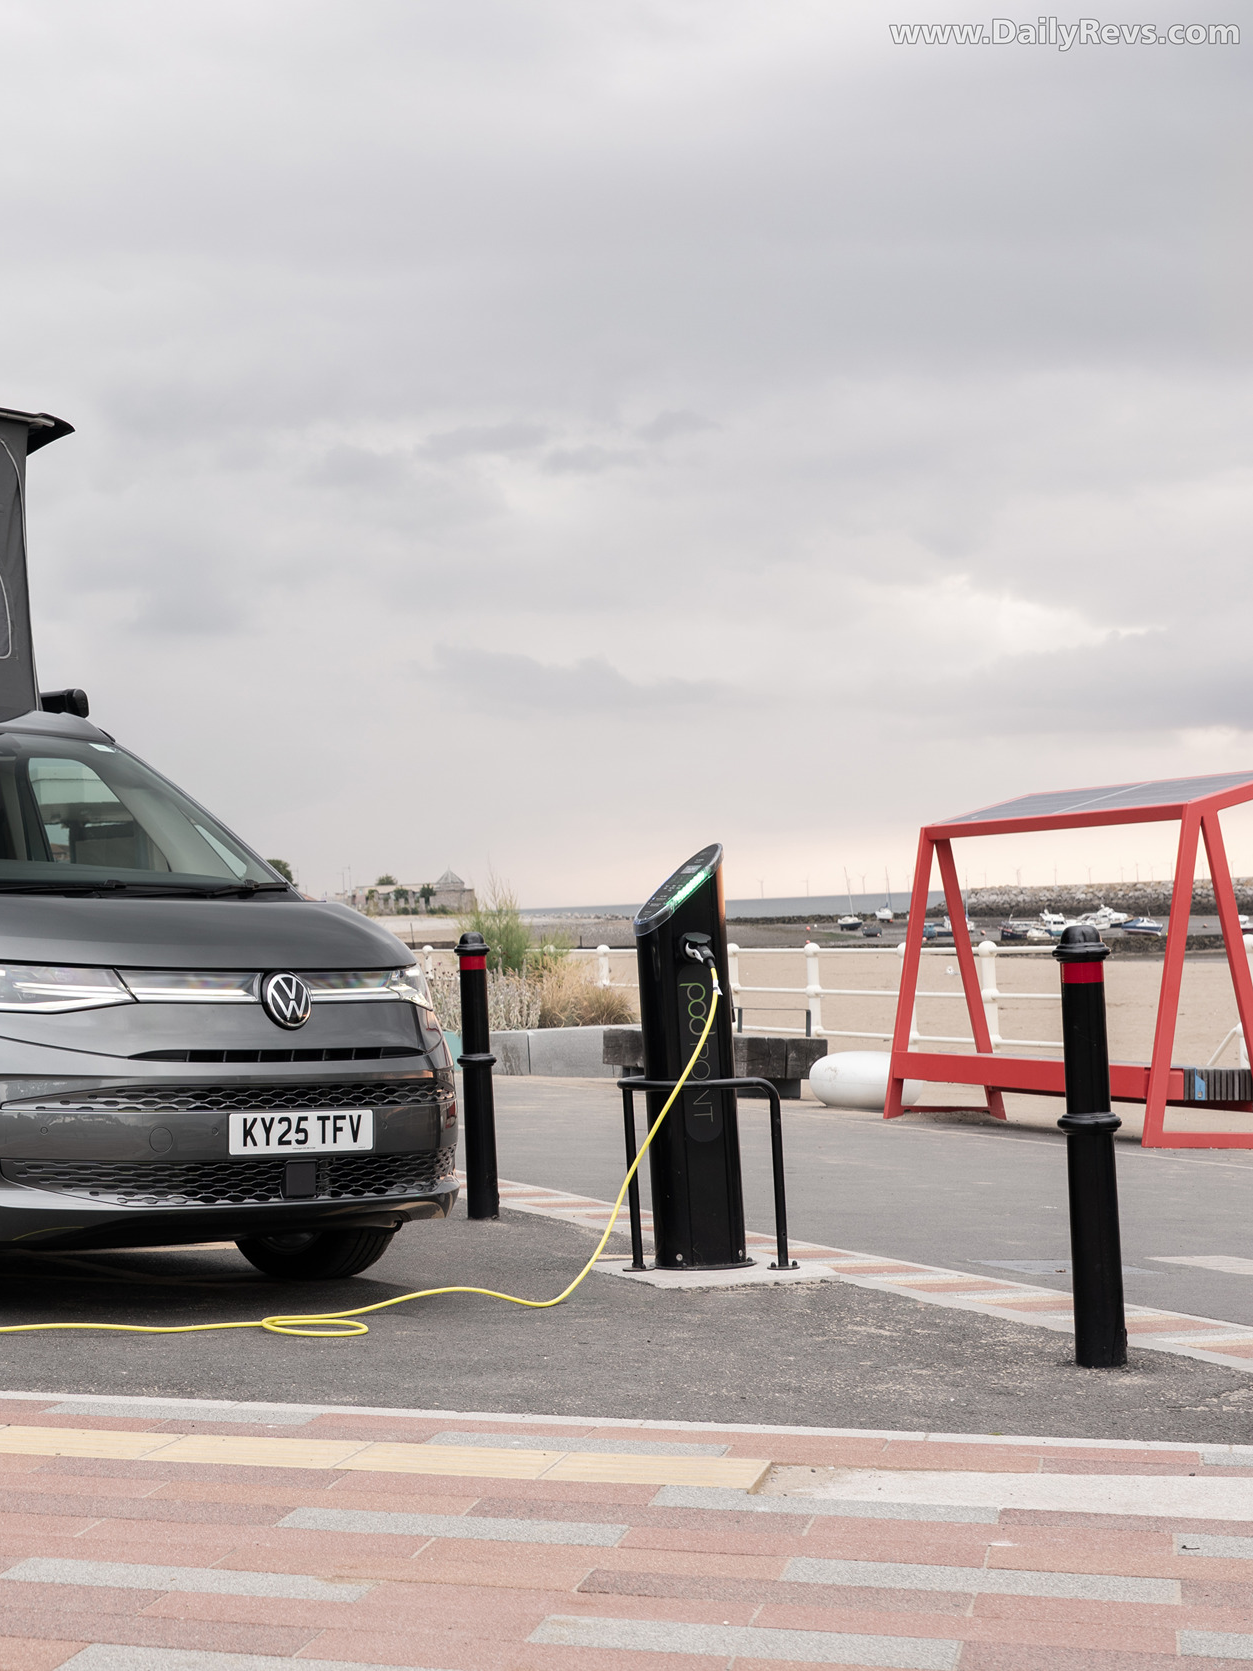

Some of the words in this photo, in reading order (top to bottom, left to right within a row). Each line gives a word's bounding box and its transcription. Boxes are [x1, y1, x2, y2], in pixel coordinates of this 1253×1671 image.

[689, 1042, 714, 1123] PONT
[242, 1115, 309, 1147] KY25
[316, 1114, 362, 1144] TFV
